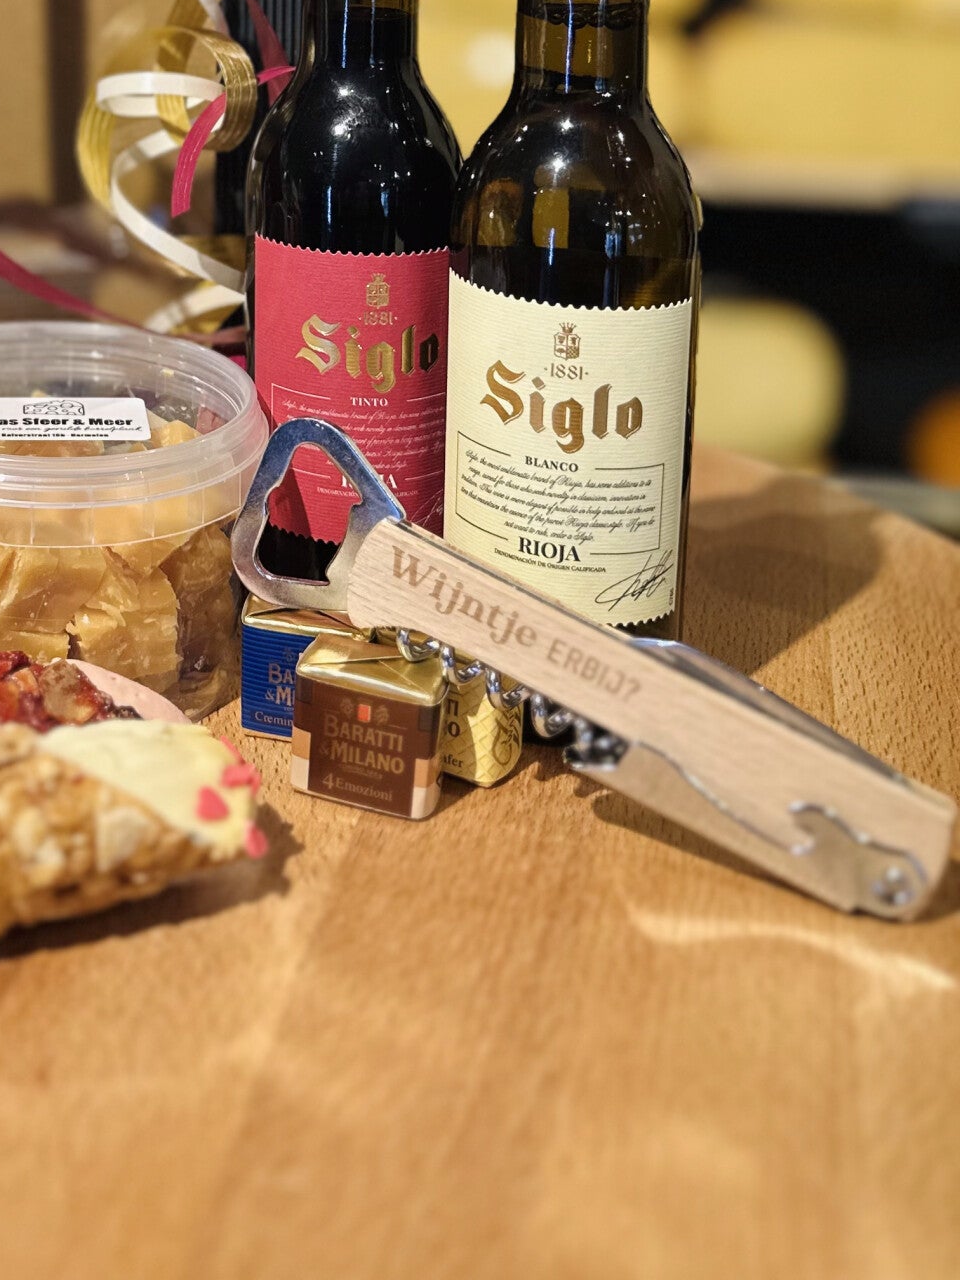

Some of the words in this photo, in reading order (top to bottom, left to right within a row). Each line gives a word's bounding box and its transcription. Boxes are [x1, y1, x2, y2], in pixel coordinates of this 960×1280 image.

[294, 314, 440, 394] Siglo
[350, 396, 389, 407] TINTO
[479, 359, 643, 455] Siglo
[73, 417, 84, 426] &
[88, 417, 133, 426] Meer
[525, 455, 579, 473] BLANCO
[518, 536, 581, 564] RIOJA
[391, 544, 539, 649] Wijntje
[254, 710, 295, 727] Cremin
[323, 713, 404, 753] BARATTI
[335, 777, 394, 802] Emozioni
